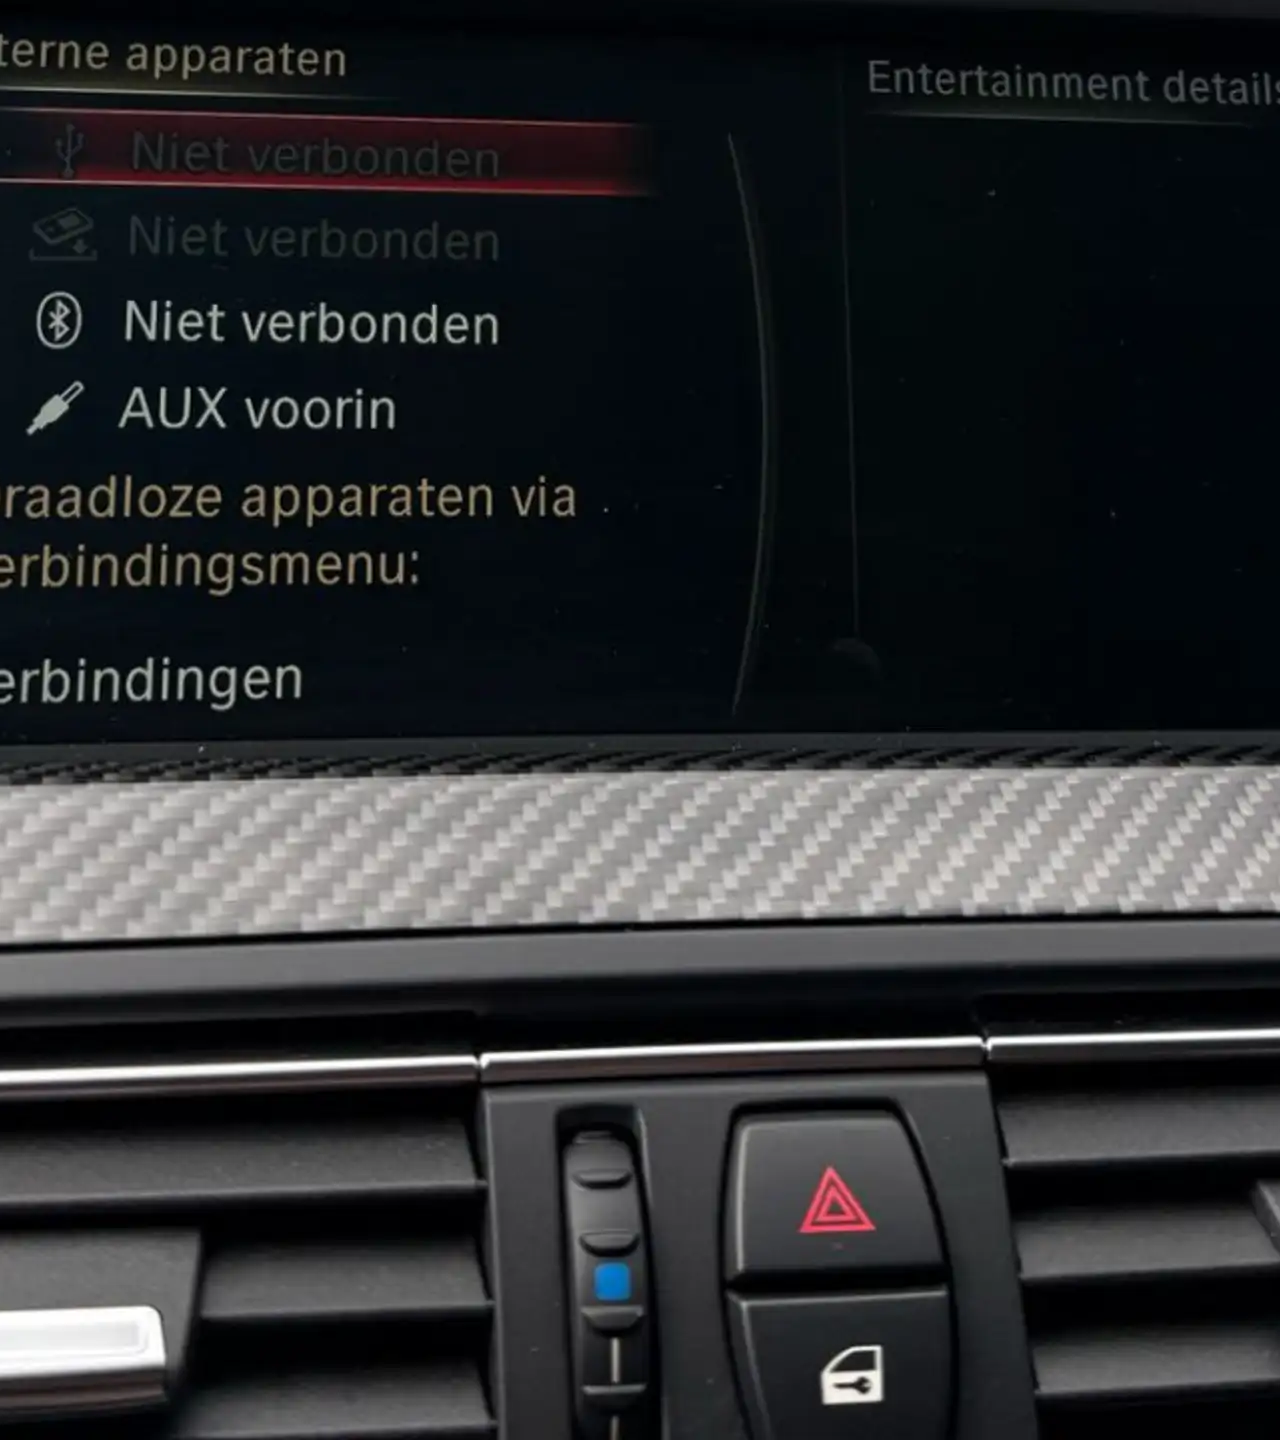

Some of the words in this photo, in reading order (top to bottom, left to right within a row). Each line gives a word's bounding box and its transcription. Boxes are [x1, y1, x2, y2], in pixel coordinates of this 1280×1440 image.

[125, 41, 348, 80] apparaten
[868, 60, 1150, 102] Entertainment
[131, 131, 229, 174] Niet
[245, 136, 501, 178] verbonden
[129, 214, 228, 256] Niet
[244, 219, 499, 261] verbonden
[125, 300, 225, 342] Niet
[241, 302, 498, 345] verbonden
[118, 386, 226, 429] AUX
[244, 388, 395, 429] voorin
[241, 478, 493, 528] apparaten
[511, 475, 576, 517] via
